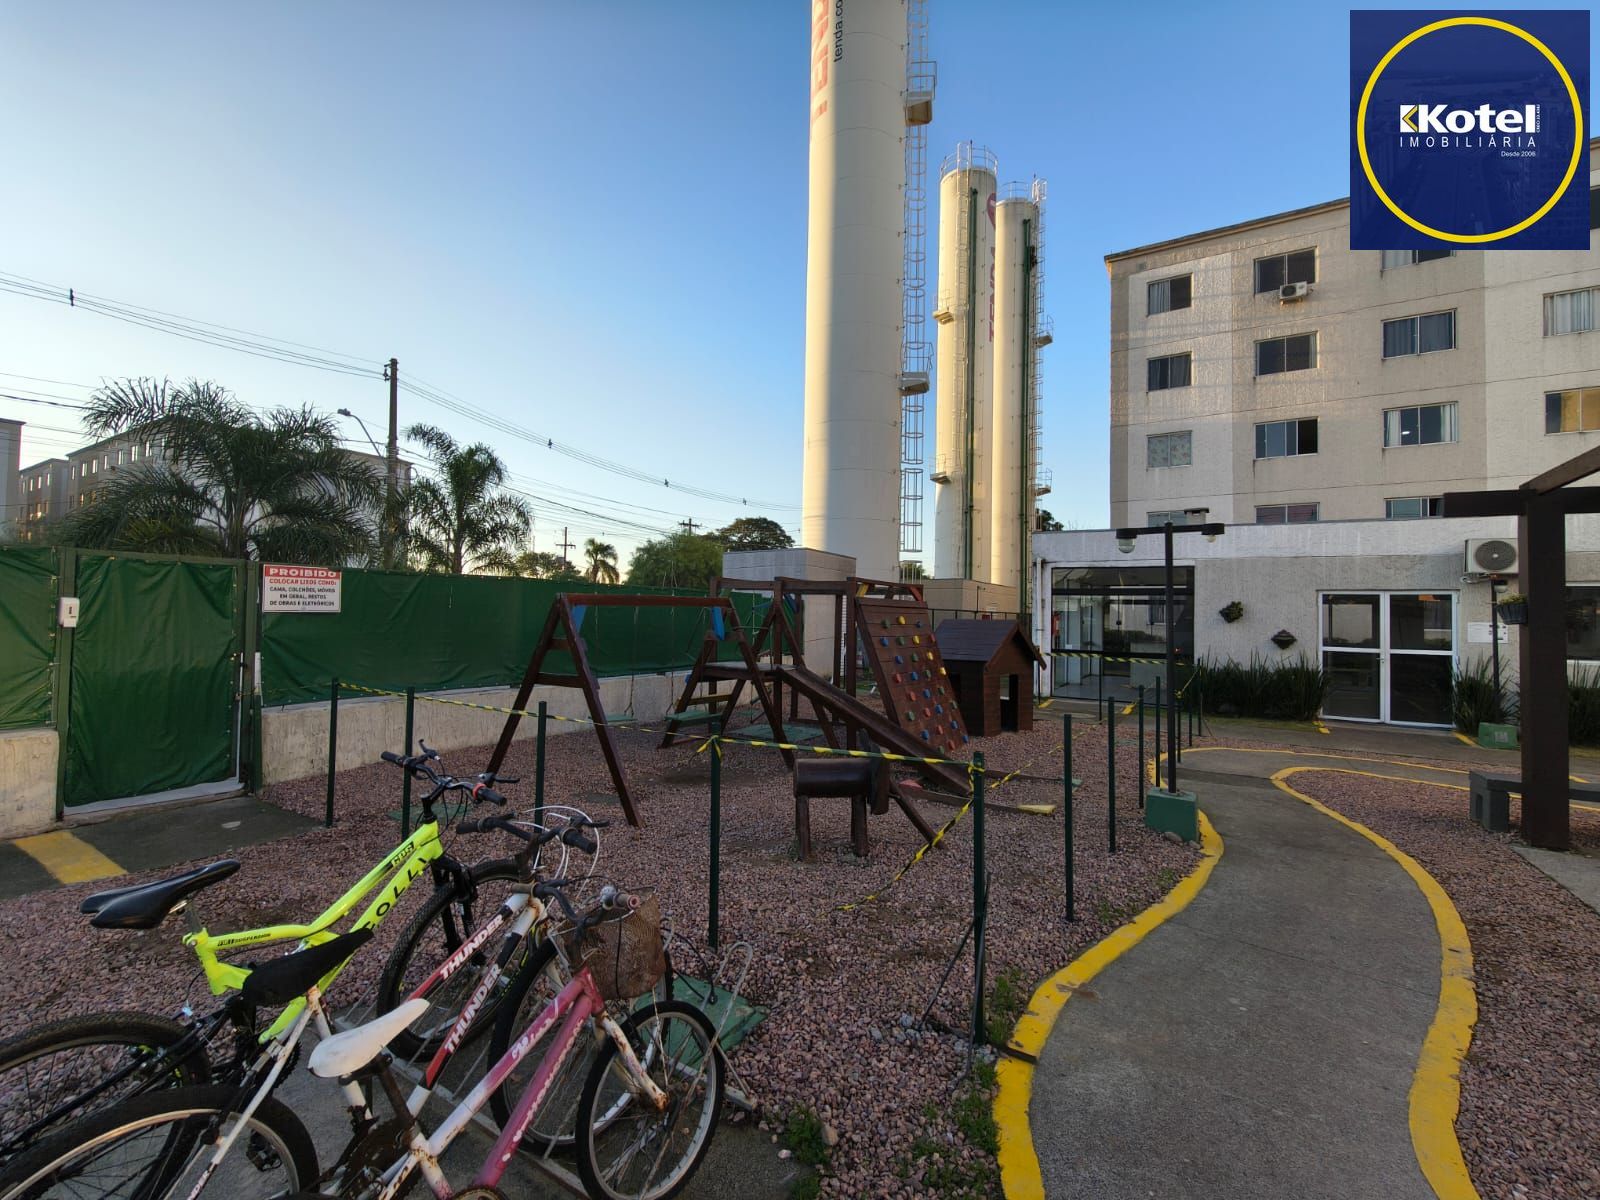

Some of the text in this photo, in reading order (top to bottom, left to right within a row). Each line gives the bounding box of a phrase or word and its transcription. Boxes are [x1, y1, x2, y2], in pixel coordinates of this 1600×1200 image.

[269, 567, 337, 578] PROIBIDO
[439, 914, 503, 980] THUNDER
[445, 963, 502, 1053] THUNDER
